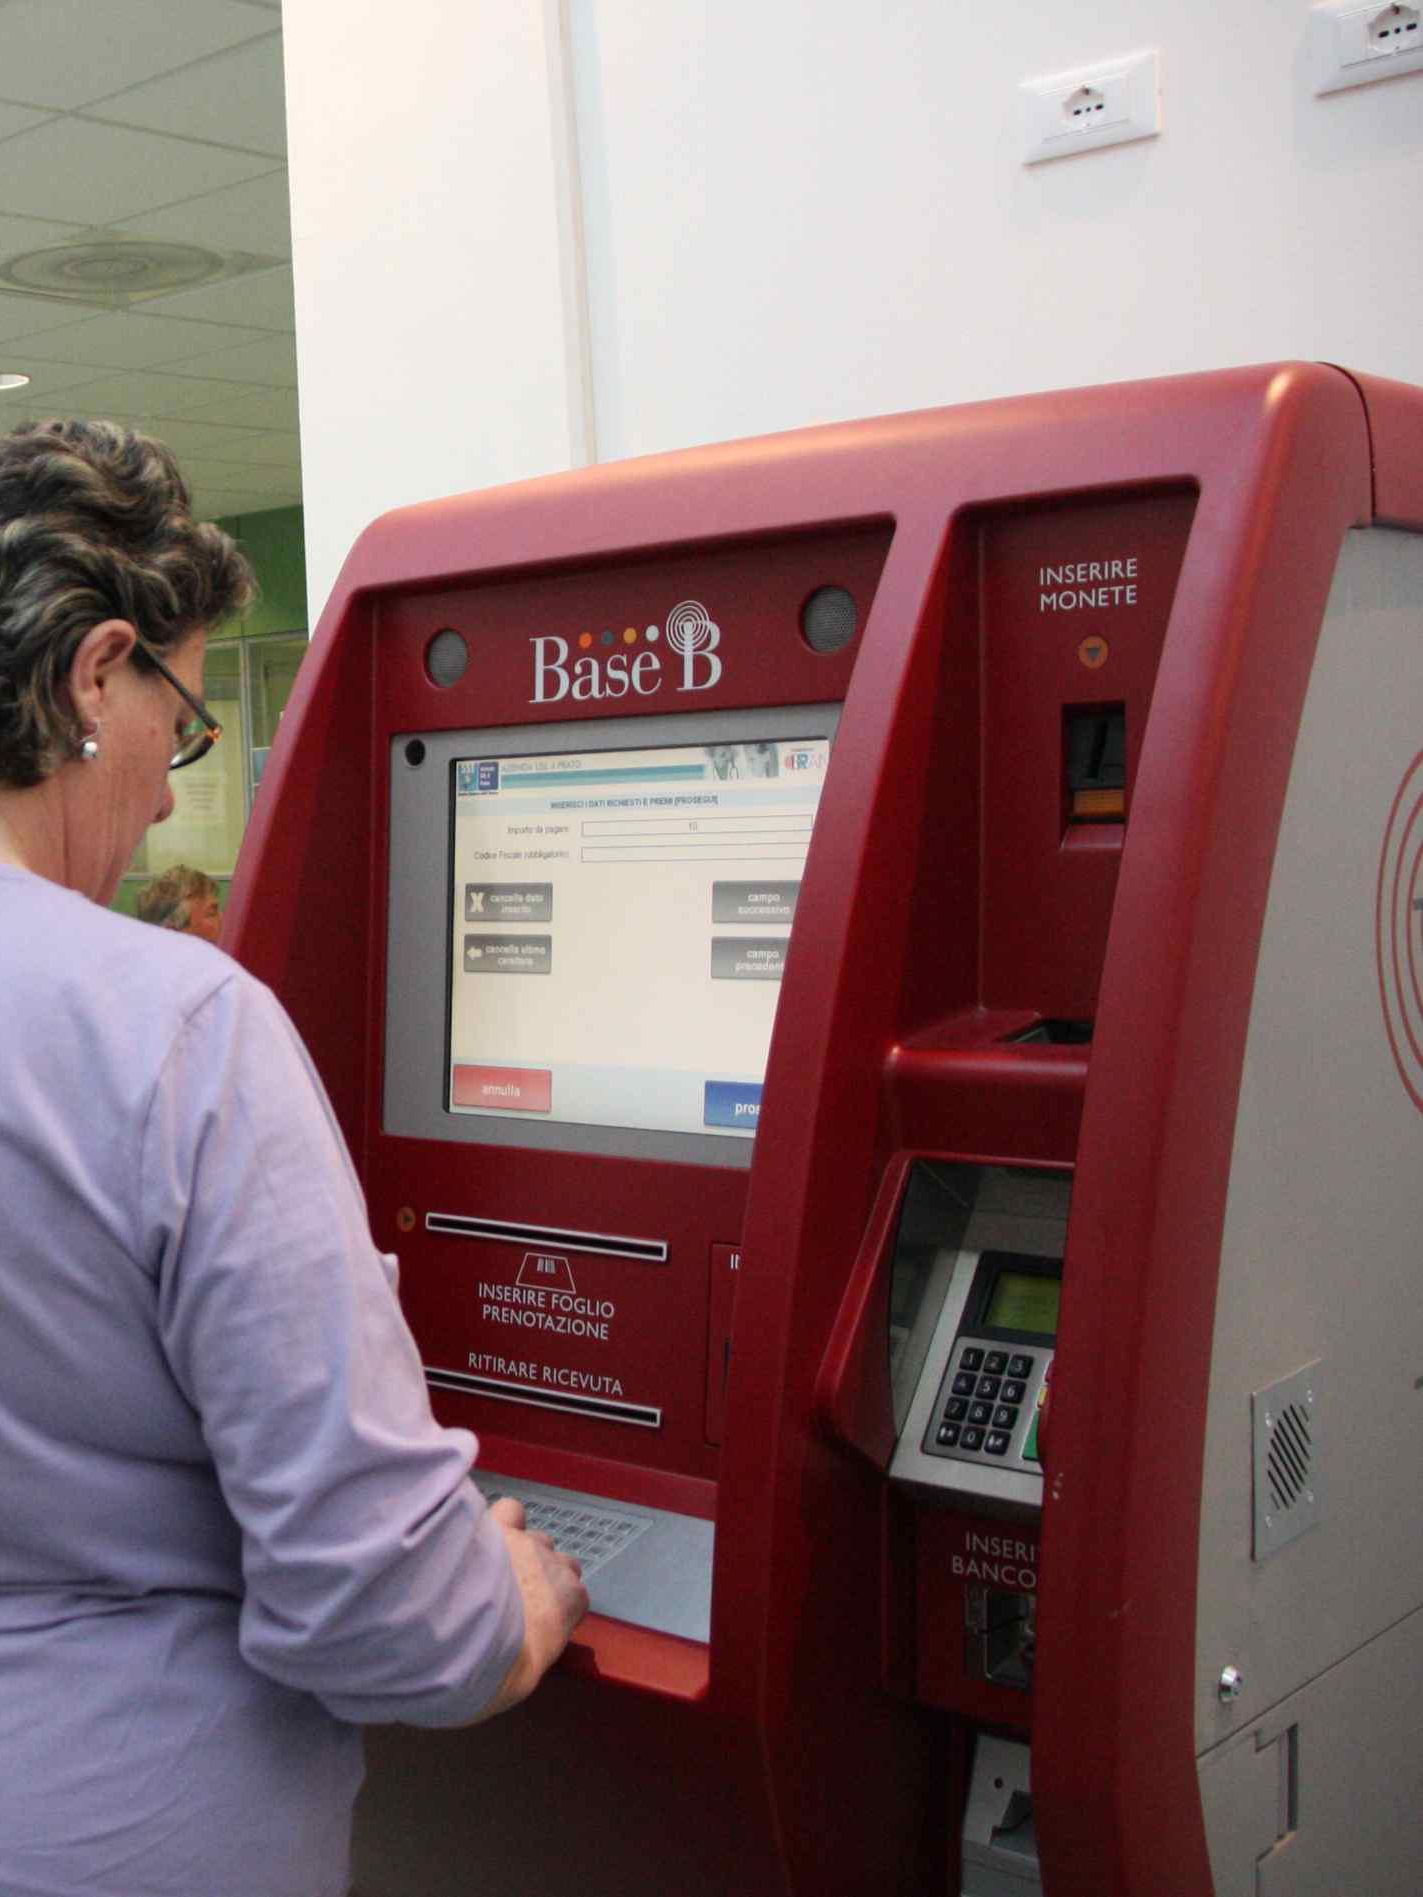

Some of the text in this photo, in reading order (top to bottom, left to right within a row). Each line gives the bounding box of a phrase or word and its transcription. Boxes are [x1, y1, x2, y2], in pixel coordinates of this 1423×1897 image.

[1039, 558, 1138, 585] INSERIRE
[1040, 586, 1138, 611] MONETE
[529, 600, 723, 704] Base B
[747, 893, 781, 905] campo
[746, 949, 780, 961] campo
[481, 1082, 521, 1097] annulla
[478, 1282, 615, 1318] INSERIRE FOGLIO
[482, 1305, 609, 1340] PRENOTAZIONE
[468, 1352, 623, 1396] RITIRARE RICEVUTA
[965, 1531, 1039, 1563] INSERI
